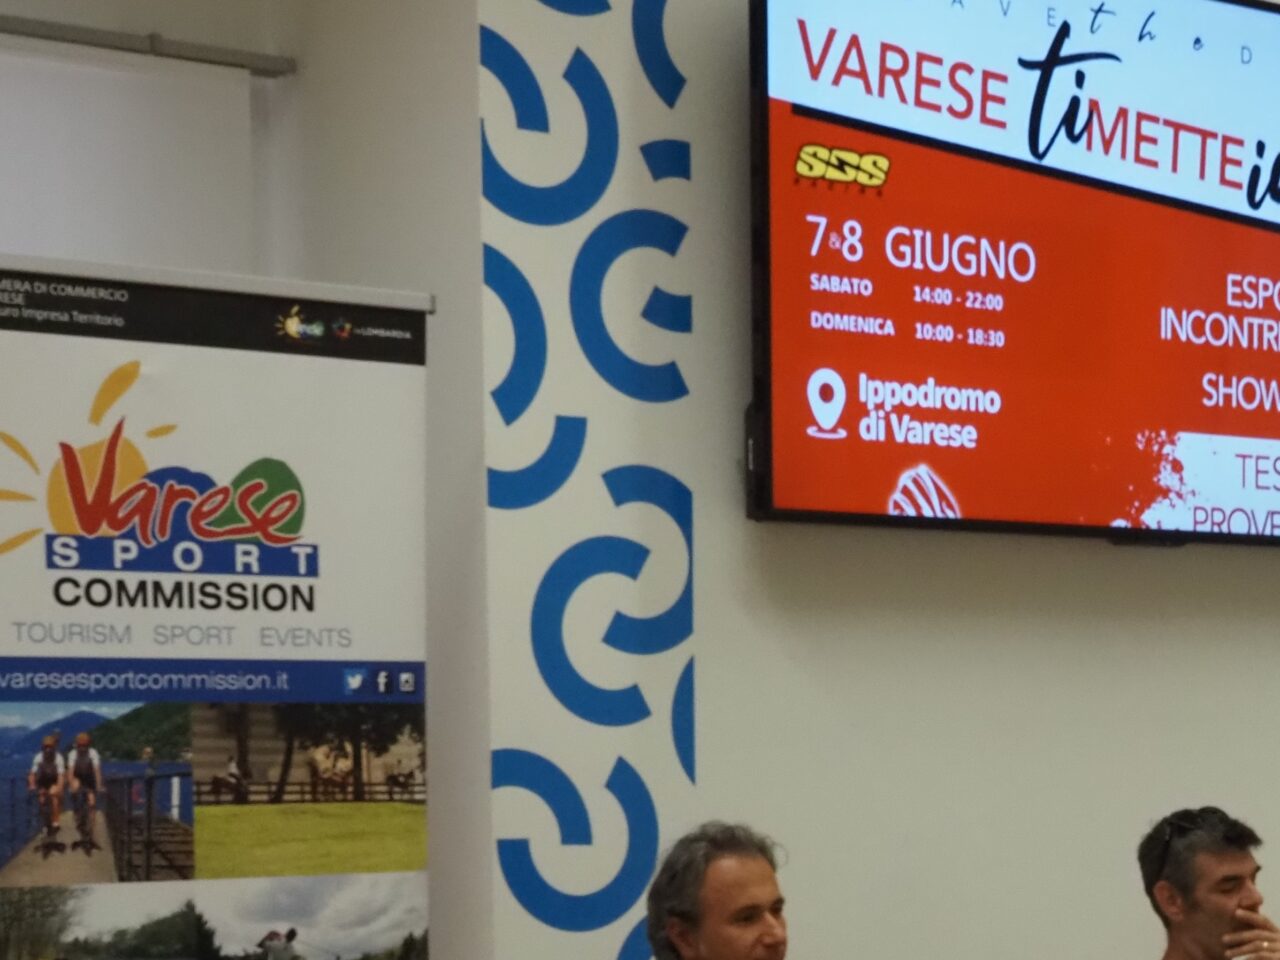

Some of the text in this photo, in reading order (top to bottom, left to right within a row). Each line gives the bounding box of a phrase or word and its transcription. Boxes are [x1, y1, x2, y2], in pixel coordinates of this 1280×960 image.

[797, 18, 1008, 129] VARESE
[1018, 20, 1122, 161] ti
[1086, 98, 1245, 190] METTE
[885, 226, 1036, 282] GIUGNO
[49, 283, 129, 302] COMMERCIO
[810, 273, 872, 296] SABATO
[913, 285, 952, 305] 14:00
[965, 291, 1004, 310] 22:00
[810, 311, 895, 336] DOMENICA
[915, 323, 954, 342] 10:00
[967, 328, 1005, 347] 18:30
[859, 373, 1001, 414] Ippodromo
[859, 410, 978, 449] di Varese
[59, 416, 303, 547] Varese
[52, 536, 314, 575] SPORT
[53, 577, 315, 612] COMMISSION
[12, 621, 352, 648] TOURISM SPORT EVENTS
